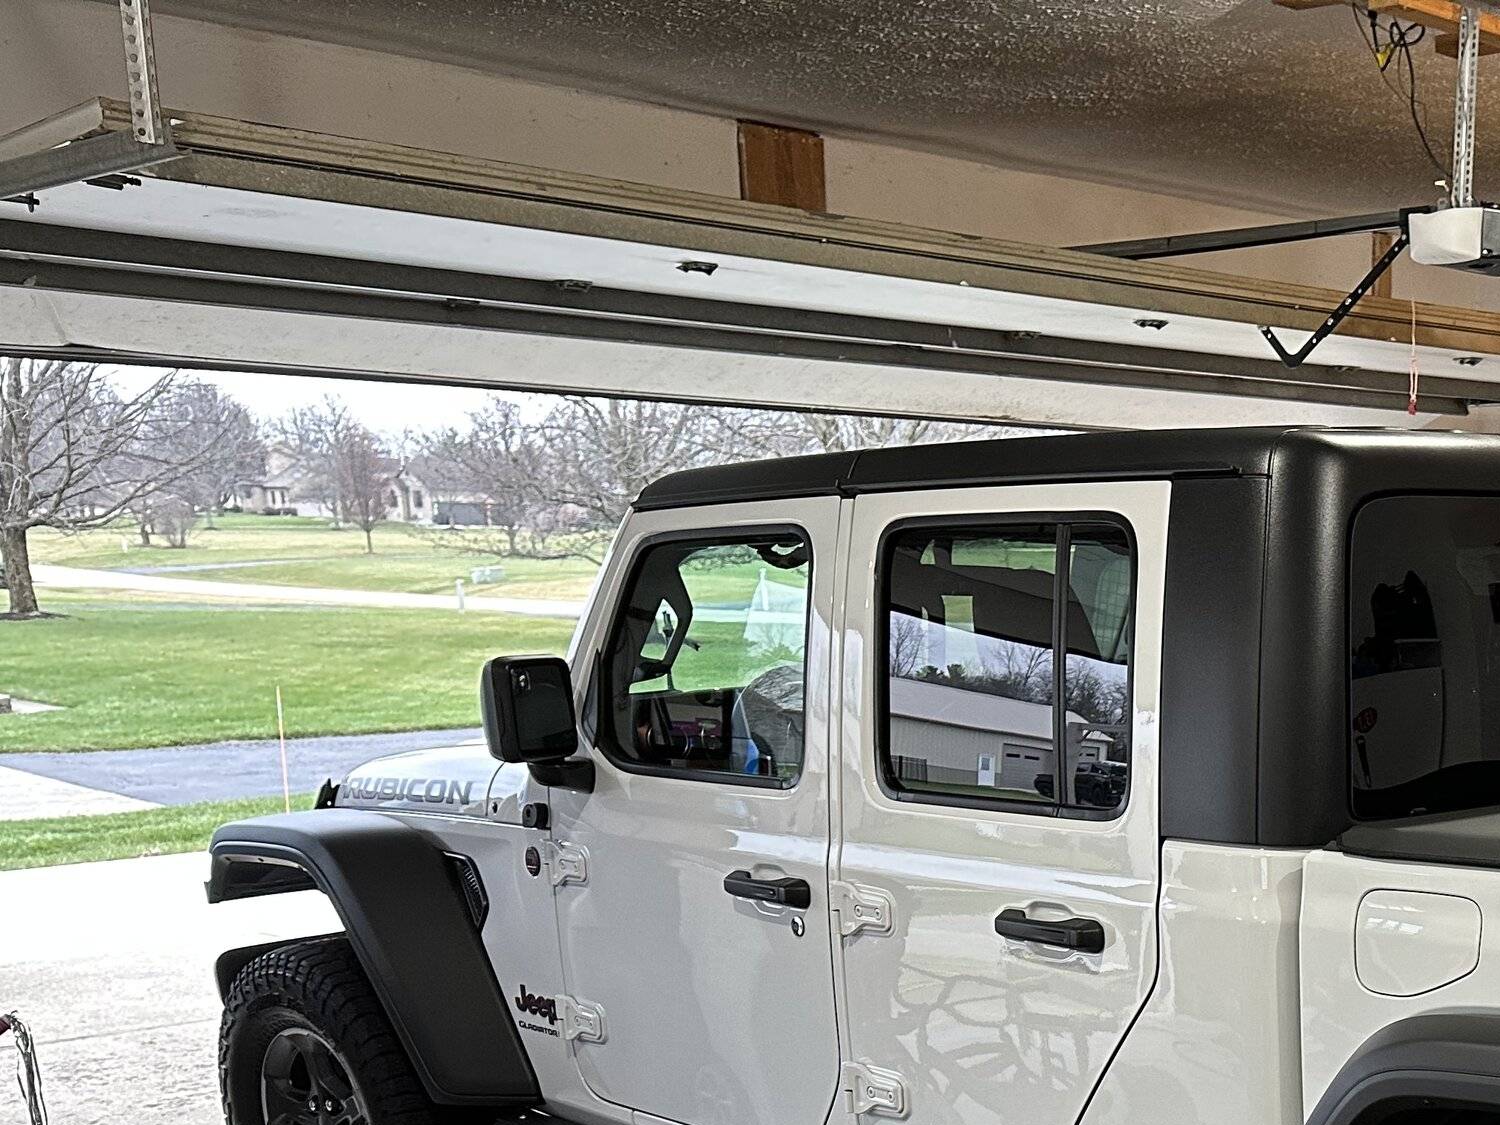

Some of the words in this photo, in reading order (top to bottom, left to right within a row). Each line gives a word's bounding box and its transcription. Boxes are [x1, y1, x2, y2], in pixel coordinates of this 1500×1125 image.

[343, 777, 473, 805] RUBICON
[515, 984, 558, 1025] Jeep
[518, 1020, 561, 1038] GLADIATOR
